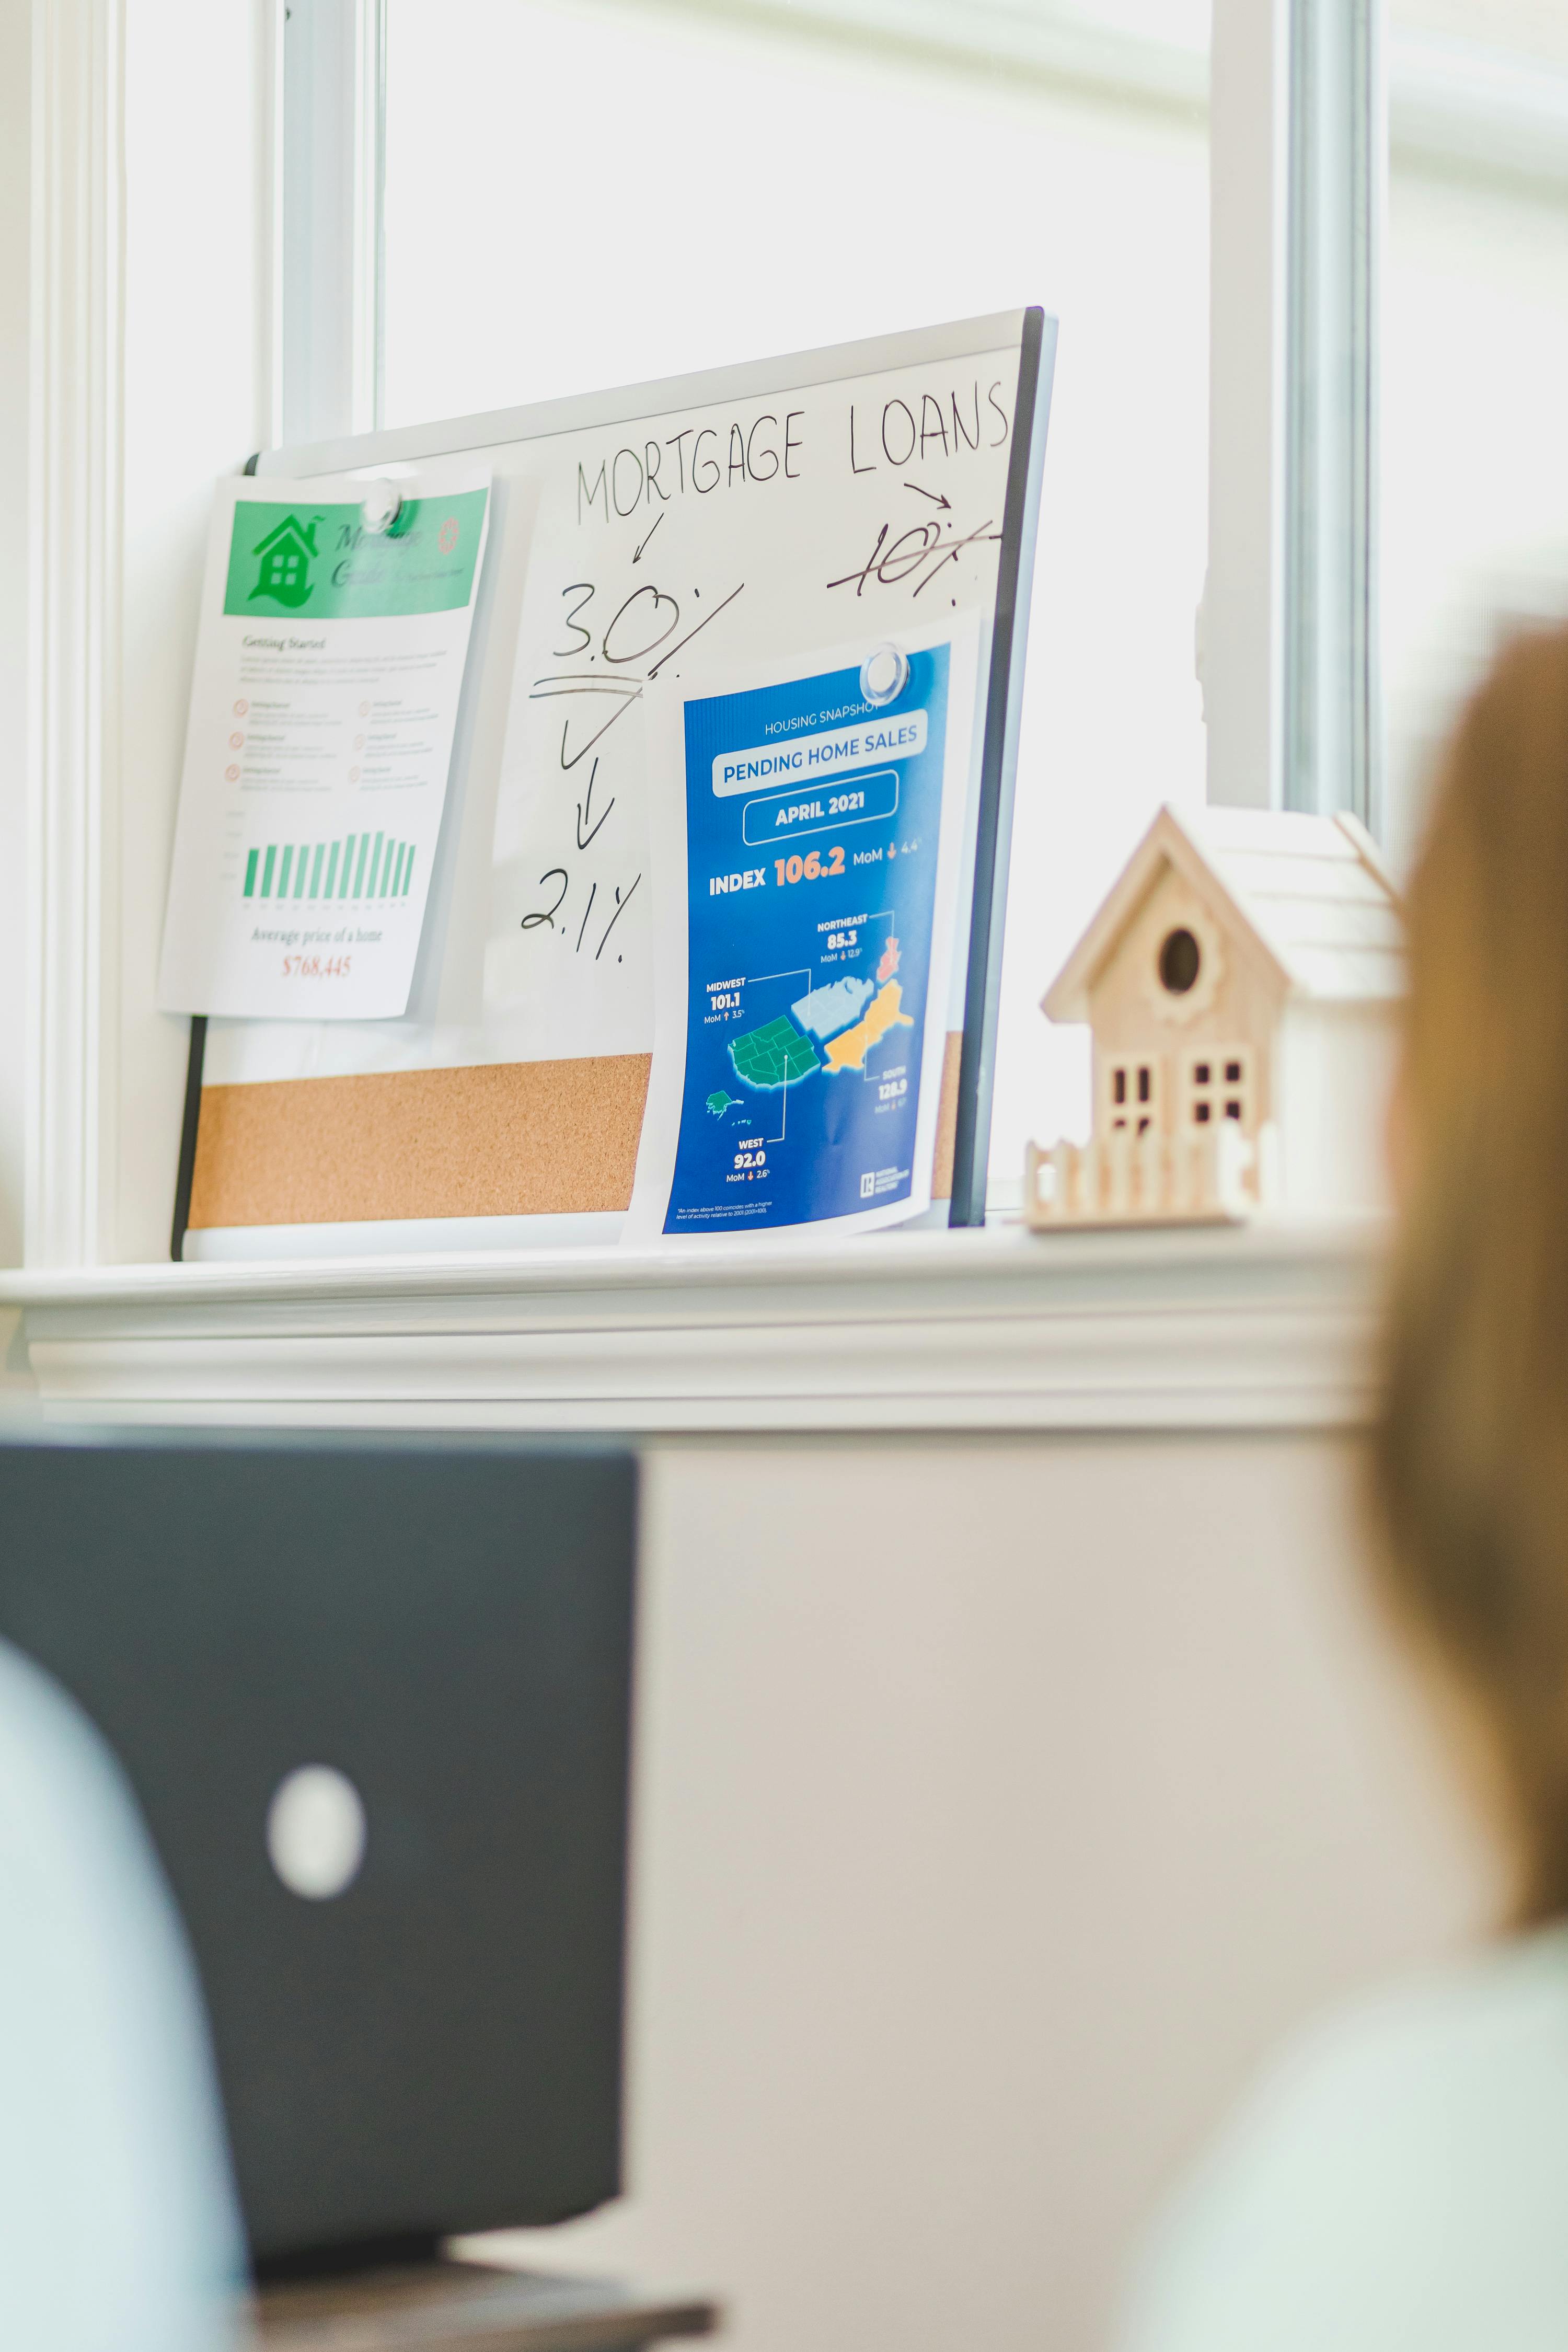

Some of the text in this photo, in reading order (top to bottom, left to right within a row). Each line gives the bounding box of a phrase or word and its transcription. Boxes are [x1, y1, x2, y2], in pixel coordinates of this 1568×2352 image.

[578, 380, 1008, 523] MORTGAGE LOANS
[765, 713, 817, 735] HOUSING
[723, 724, 917, 783] PENDING HOME SALES
[775, 791, 864, 826] APRIL 2021
[709, 867, 766, 896] INDEX
[775, 846, 845, 887] 106.2
[853, 847, 883, 866] MoM
[817, 913, 868, 932] NORTHEAST
[251, 927, 299, 946] Average
[302, 927, 331, 947] price
[334, 927, 347, 942] of
[355, 927, 383, 942] home
[827, 929, 858, 950] 85.3
[281, 955, 352, 977] $768,445
[820, 952, 837, 963] MoM
[706, 976, 746, 993] MIDWEST
[711, 991, 740, 1011] 101.1
[704, 1013, 721, 1024] MoM
[739, 1137, 764, 1149] WEST
[734, 1150, 766, 1169] 92.0
[726, 1172, 745, 1183] MoM
